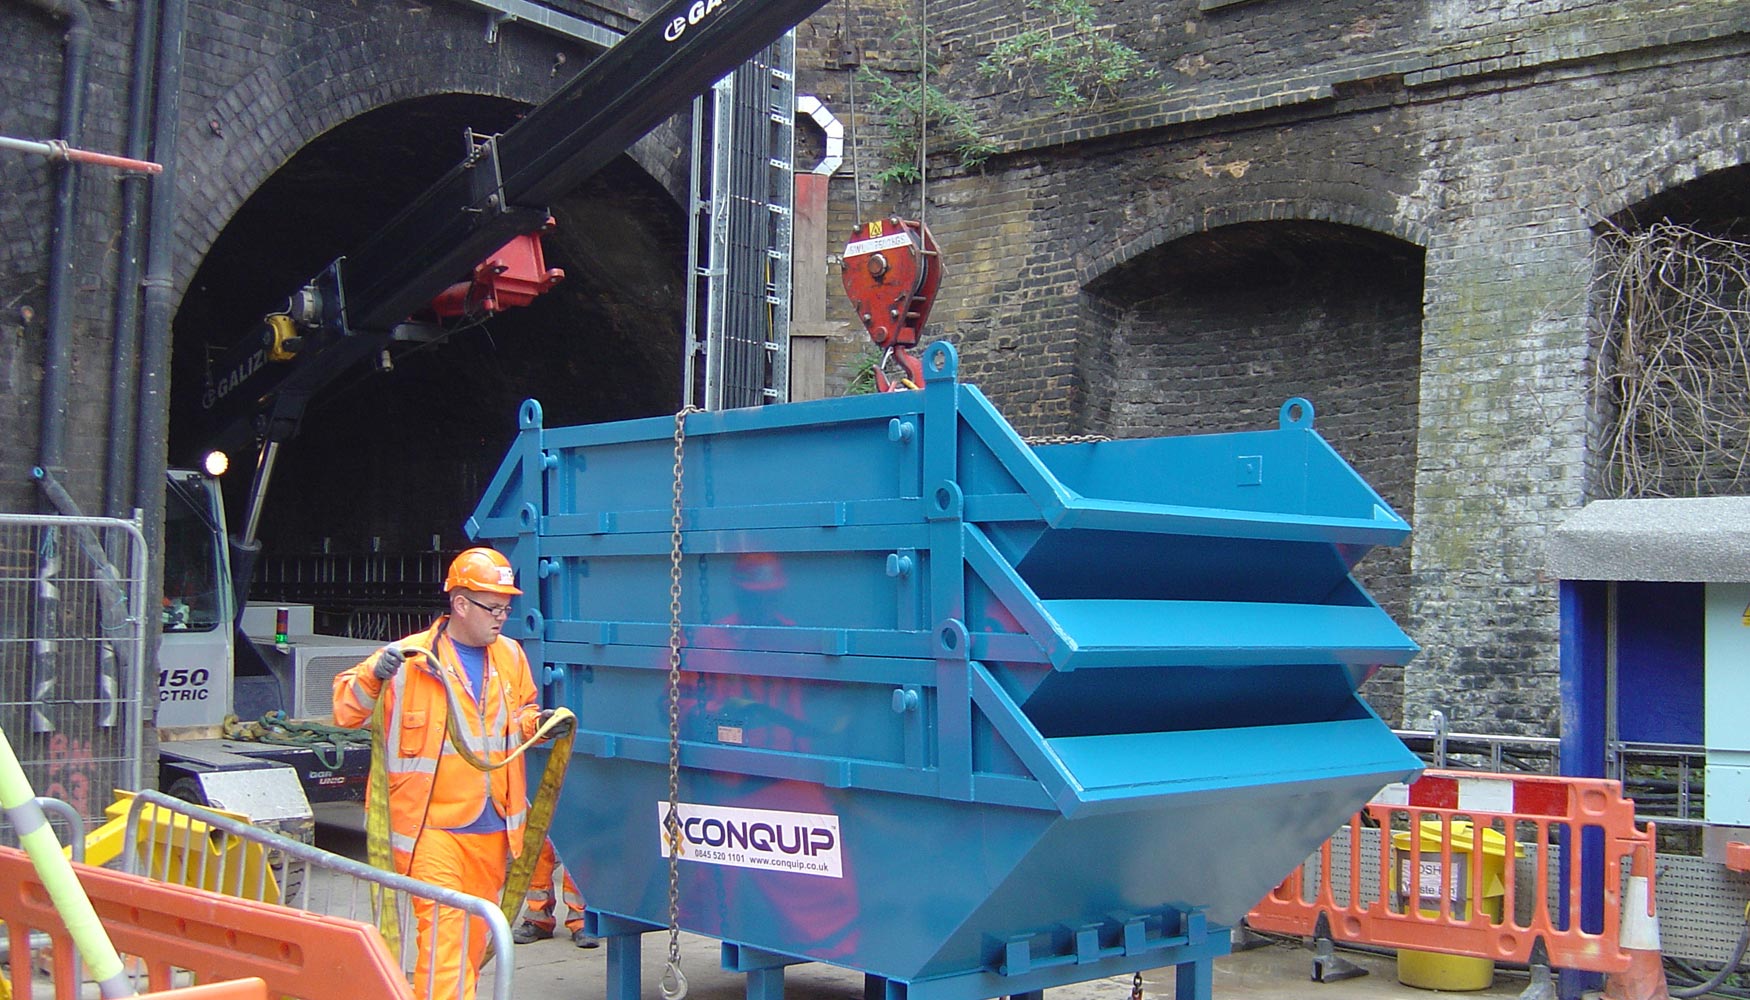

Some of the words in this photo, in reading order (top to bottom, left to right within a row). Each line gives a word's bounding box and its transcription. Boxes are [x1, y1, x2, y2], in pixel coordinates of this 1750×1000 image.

[684, 816, 835, 857] CONQUIP
[694, 848, 712, 859] 0845
[713, 851, 726, 860] 520
[728, 853, 745, 863] 1101
[749, 855, 829, 872] www.conquip.co.uk
